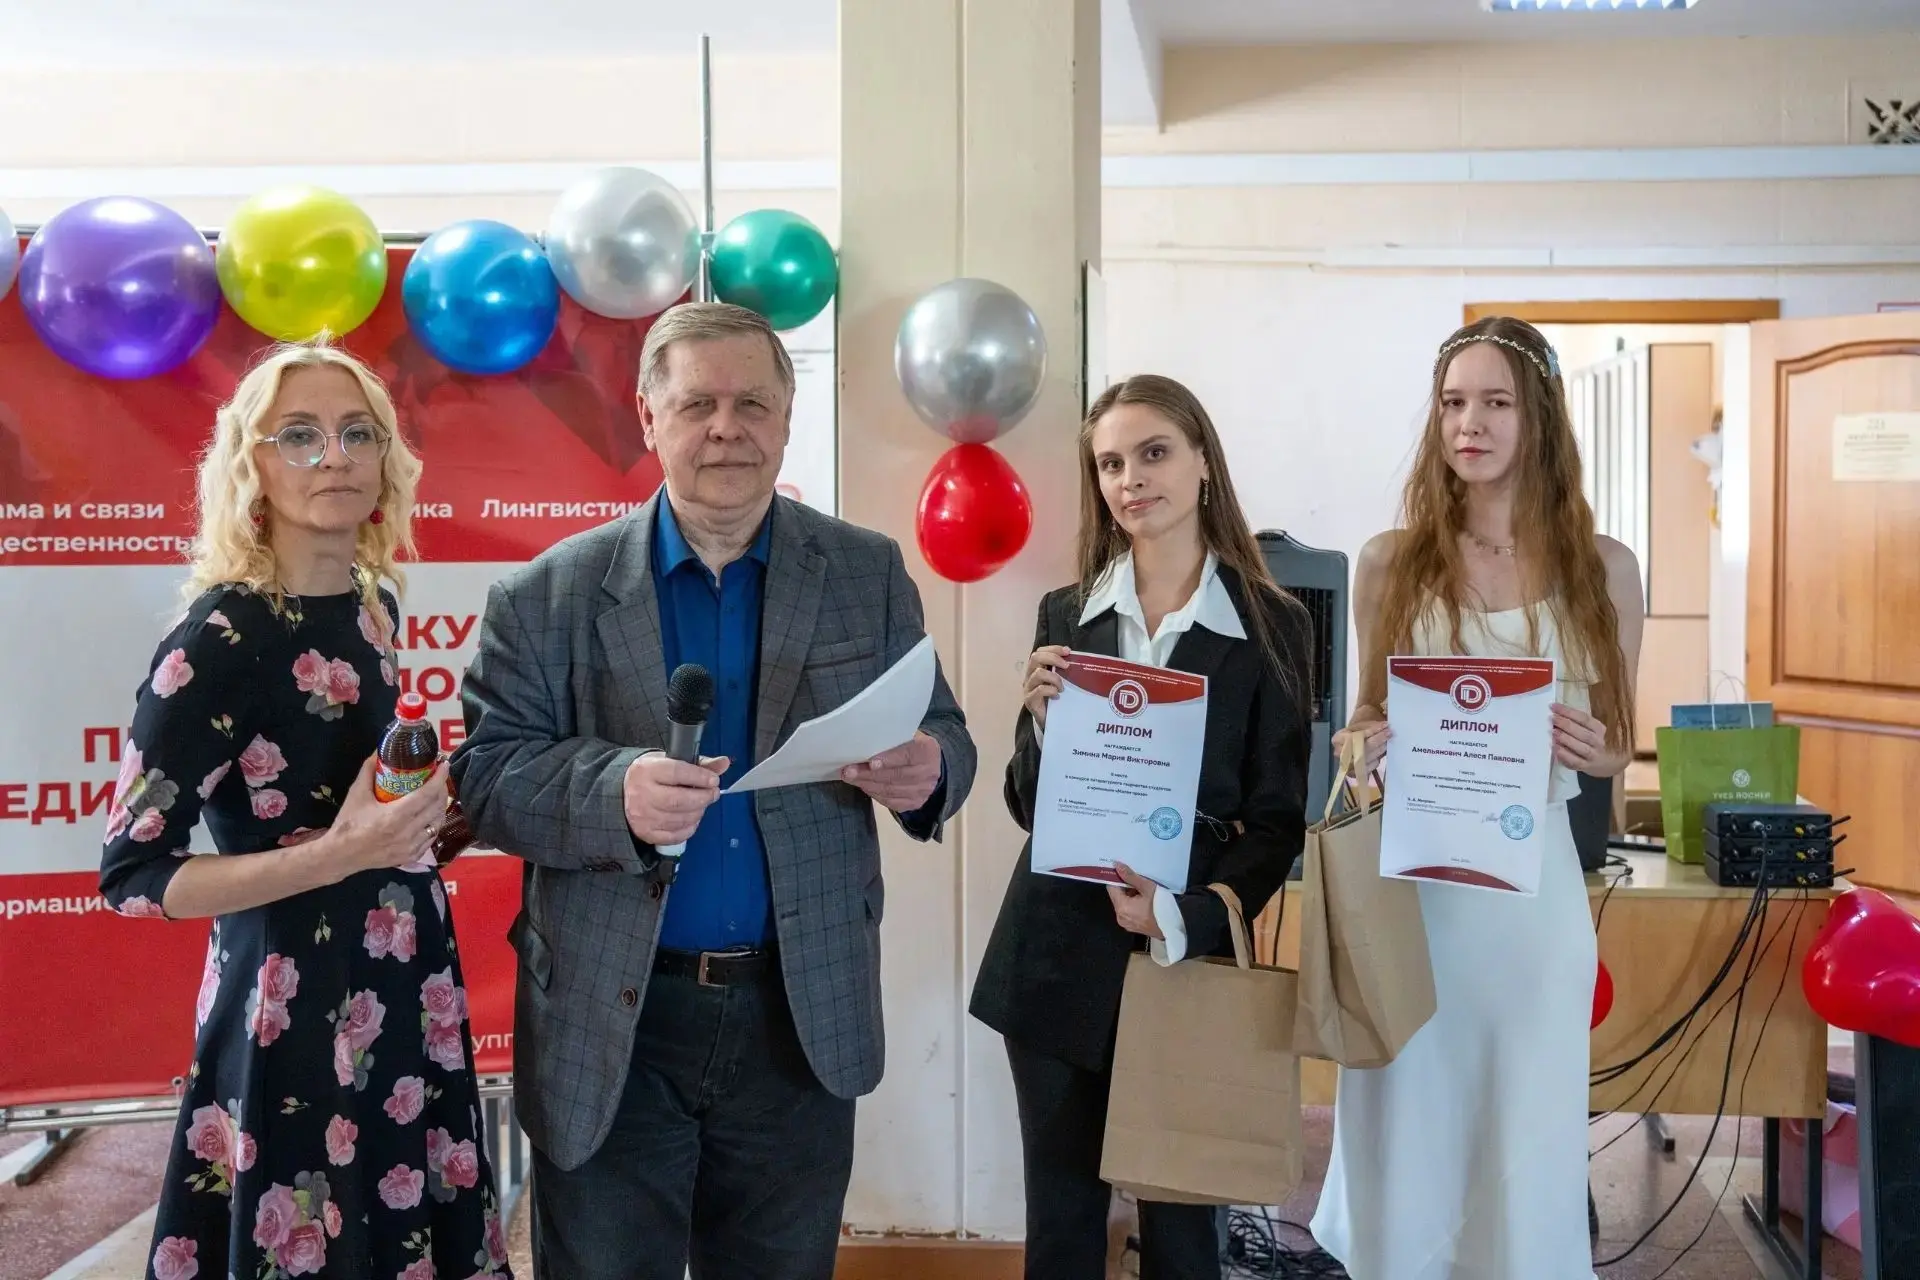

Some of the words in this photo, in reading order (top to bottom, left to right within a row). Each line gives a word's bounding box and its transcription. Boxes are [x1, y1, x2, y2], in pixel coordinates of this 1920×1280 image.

[54, 503, 72, 519] и
[80, 503, 165, 519] связи
[1096, 722, 1153, 739] ДИПЛОМ
[1440, 719, 1499, 734] ДИПЛОМ
[1072, 748, 1101, 758] Зимина
[1101, 752, 1125, 763] Мария
[1127, 756, 1171, 768] Викторовна
[1412, 746, 1462, 757] Амельянович
[1463, 751, 1487, 760] Алеся
[1488, 754, 1525, 764] Павловна
[1713, 792, 1733, 800] YVES
